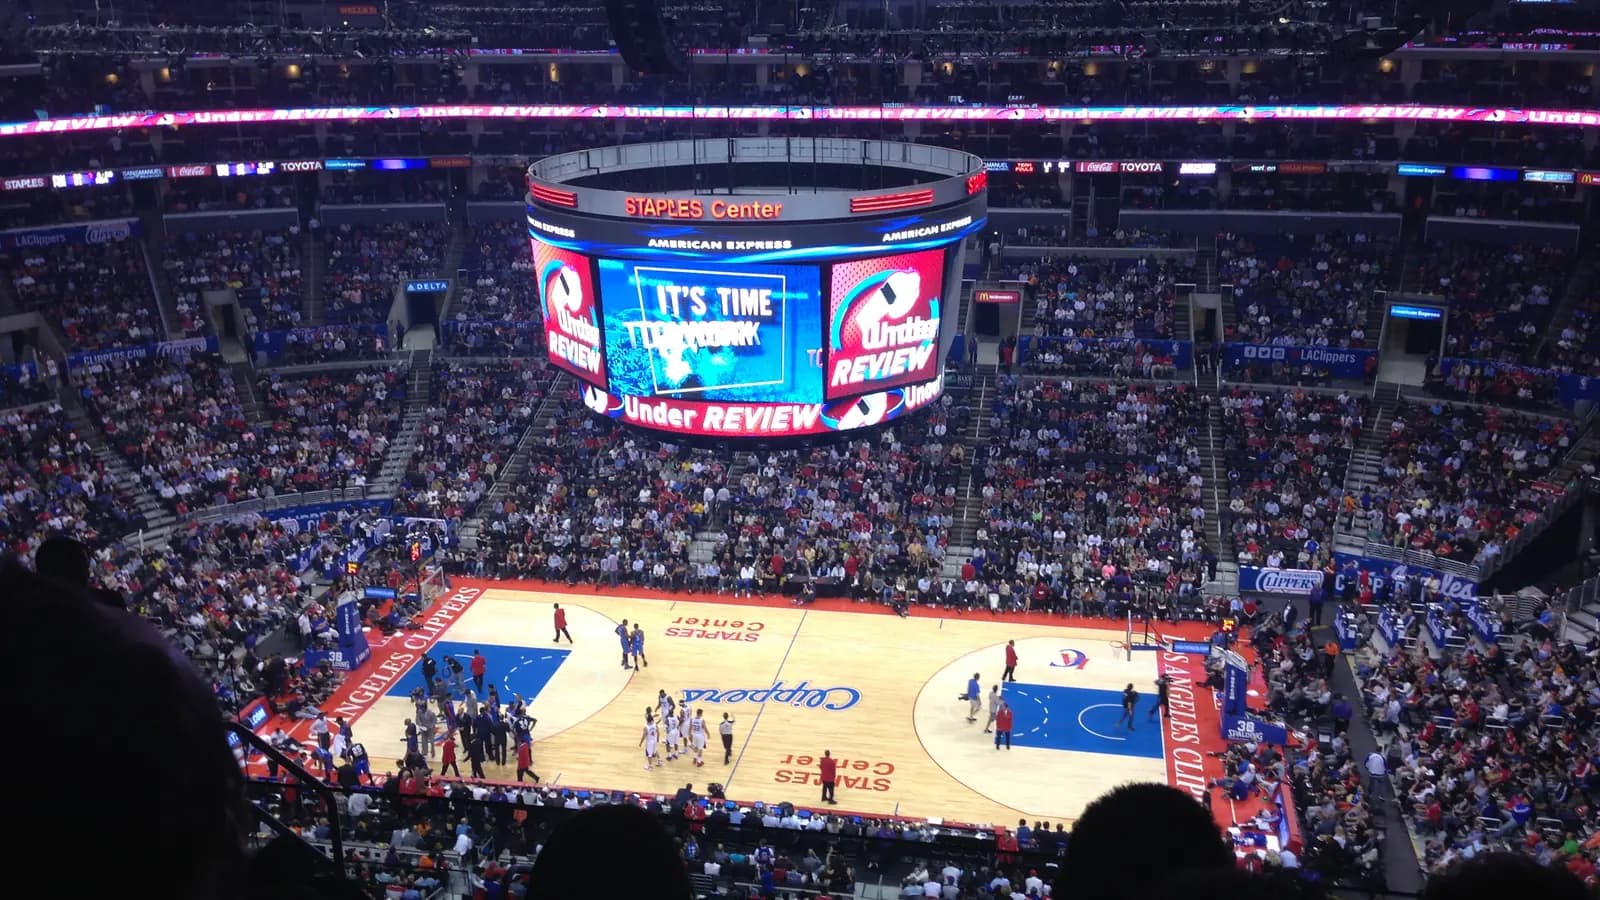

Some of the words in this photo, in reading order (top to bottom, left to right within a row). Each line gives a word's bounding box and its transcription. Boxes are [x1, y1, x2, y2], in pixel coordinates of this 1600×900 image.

[194, 111, 267, 123] Under
[271, 108, 365, 120] REVIEW
[418, 105, 485, 117] Under
[486, 106, 576, 117] REVIEW
[624, 106, 691, 118] Under
[693, 107, 779, 118] REVIEW
[829, 108, 894, 119] Under
[899, 108, 990, 119] REVIEW
[1045, 108, 1112, 119] Under
[1119, 107, 1215, 119] REVIEW
[1276, 106, 1351, 118] Under
[1357, 107, 1464, 119] REVIEW
[33, 115, 137, 132] REVIEW
[281, 161, 323, 172] TOYOTA
[1121, 163, 1163, 172] TOYOTA
[5, 178, 45, 190] STAPLES
[625, 196, 704, 219] STAPLES
[710, 200, 784, 219] Center
[882, 225, 939, 242] AMERICAN
[940, 216, 973, 233] EXPRESS
[648, 239, 722, 250] AMERICAN
[725, 241, 793, 250] EXPRESS
[416, 282, 448, 291] DELTA
[656, 284, 708, 318] IT'S
[716, 287, 774, 318] TIME
[549, 330, 601, 375] REVIEW
[1300, 349, 1357, 364] LAClippers
[831, 344, 935, 387] REVIEW
[624, 394, 699, 429] Under
[702, 406, 821, 432] REVIEW
[403, 586, 481, 651] CLIPPERS
[671, 616, 766, 632] Center
[664, 627, 761, 642] STAPLES
[681, 681, 863, 711] Clippers
